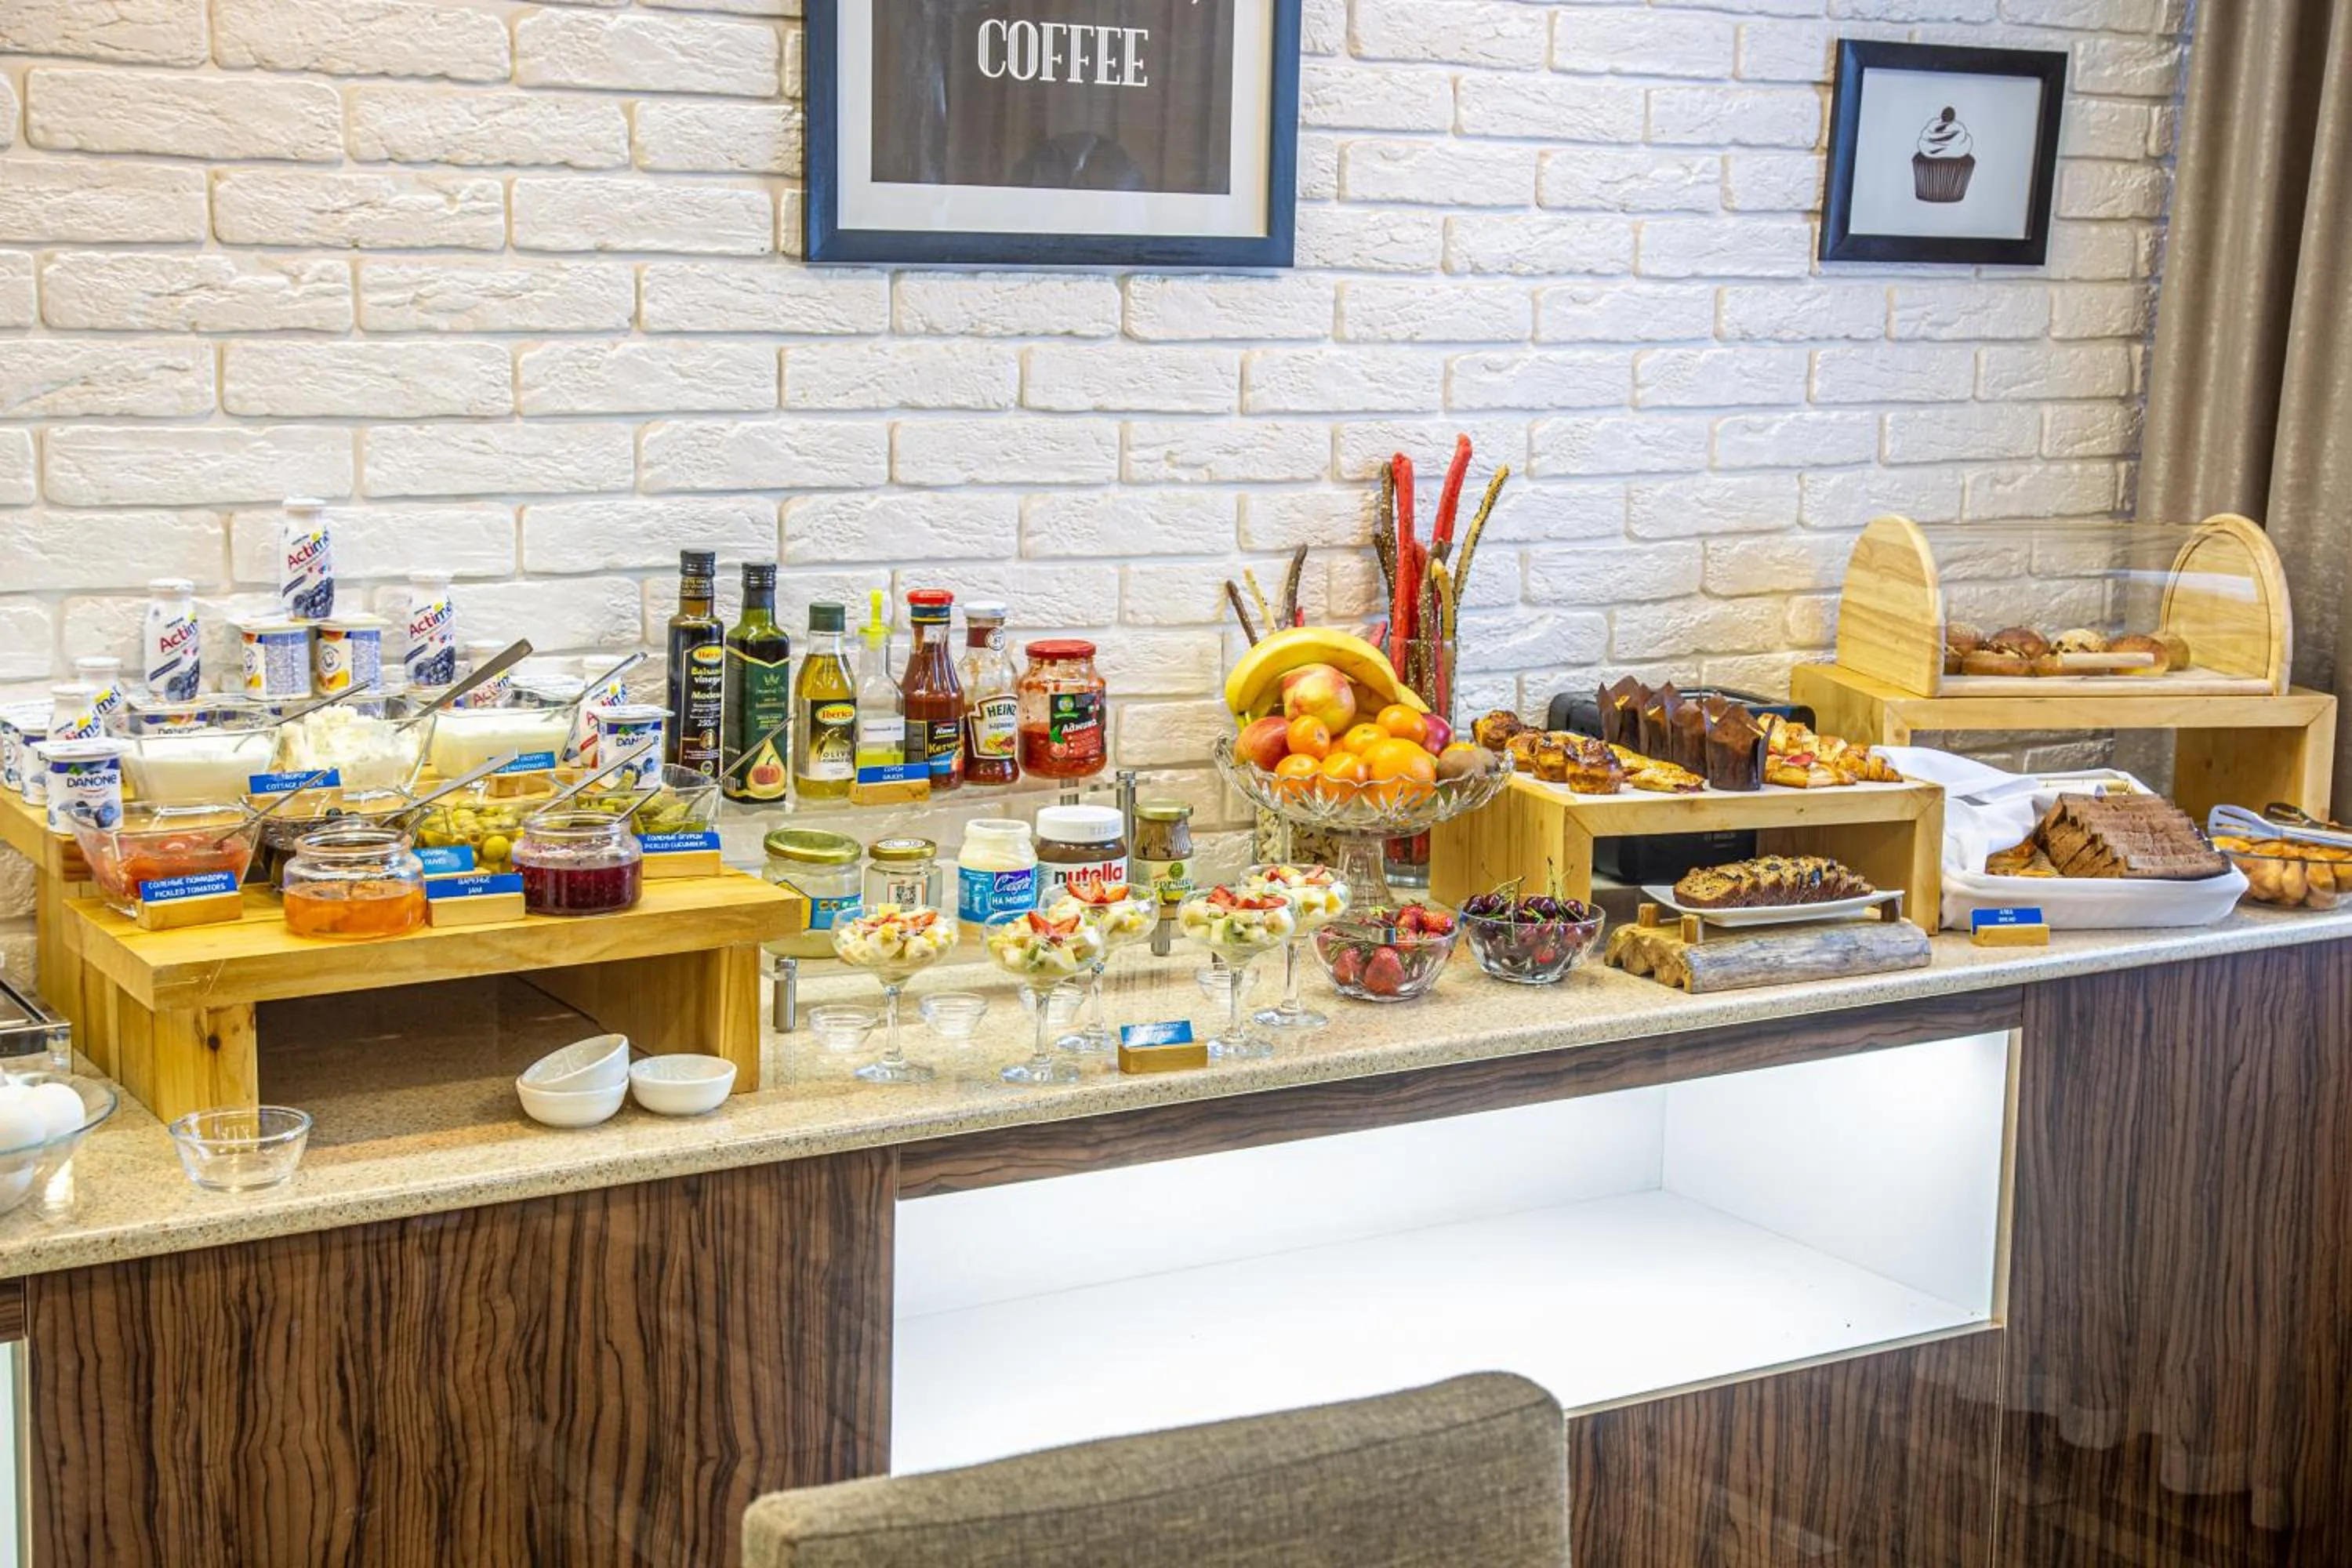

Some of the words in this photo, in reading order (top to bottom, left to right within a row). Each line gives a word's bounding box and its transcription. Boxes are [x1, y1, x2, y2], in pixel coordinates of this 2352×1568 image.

[978, 19, 1149, 87] COFFEE
[288, 528, 329, 570] Actime
[160, 617, 198, 652] Actim
[410, 601, 452, 638] Actime
[987, 704, 1017, 717] HEINZ
[67, 774, 117, 787] DANONE
[1054, 862, 1123, 884] nutella
